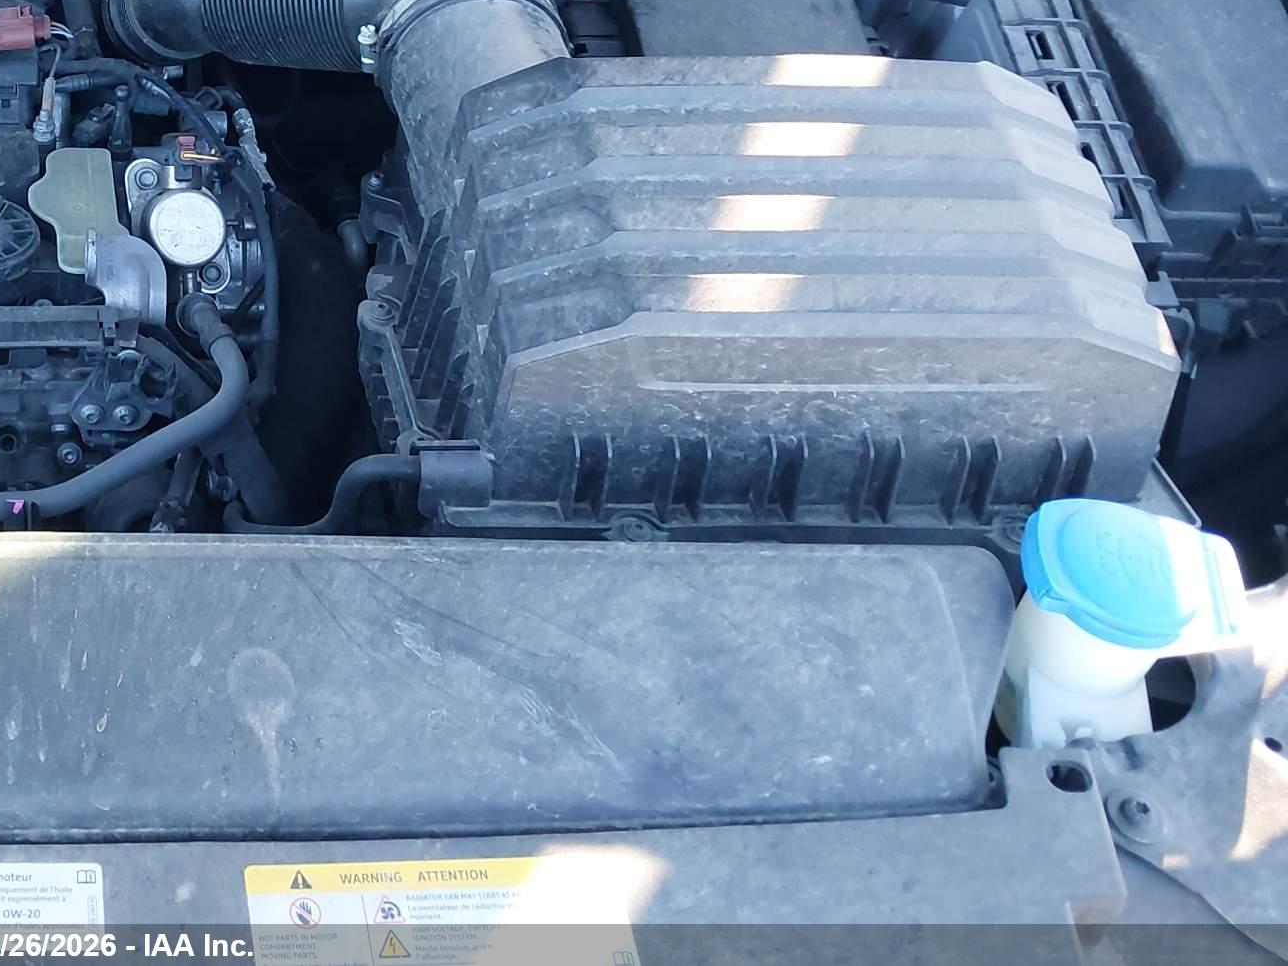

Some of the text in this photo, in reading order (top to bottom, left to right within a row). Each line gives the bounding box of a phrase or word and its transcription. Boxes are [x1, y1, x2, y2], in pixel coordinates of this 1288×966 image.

[339, 868, 489, 885] WARNING ATTENTION
[406, 893, 442, 902] RADIATOR
[2, 909, 41, 919] 0W-20
[275, 934, 299, 942] PARTS
[259, 943, 318, 952] COMPARTMENT
[261, 952, 292, 960] MOVING
